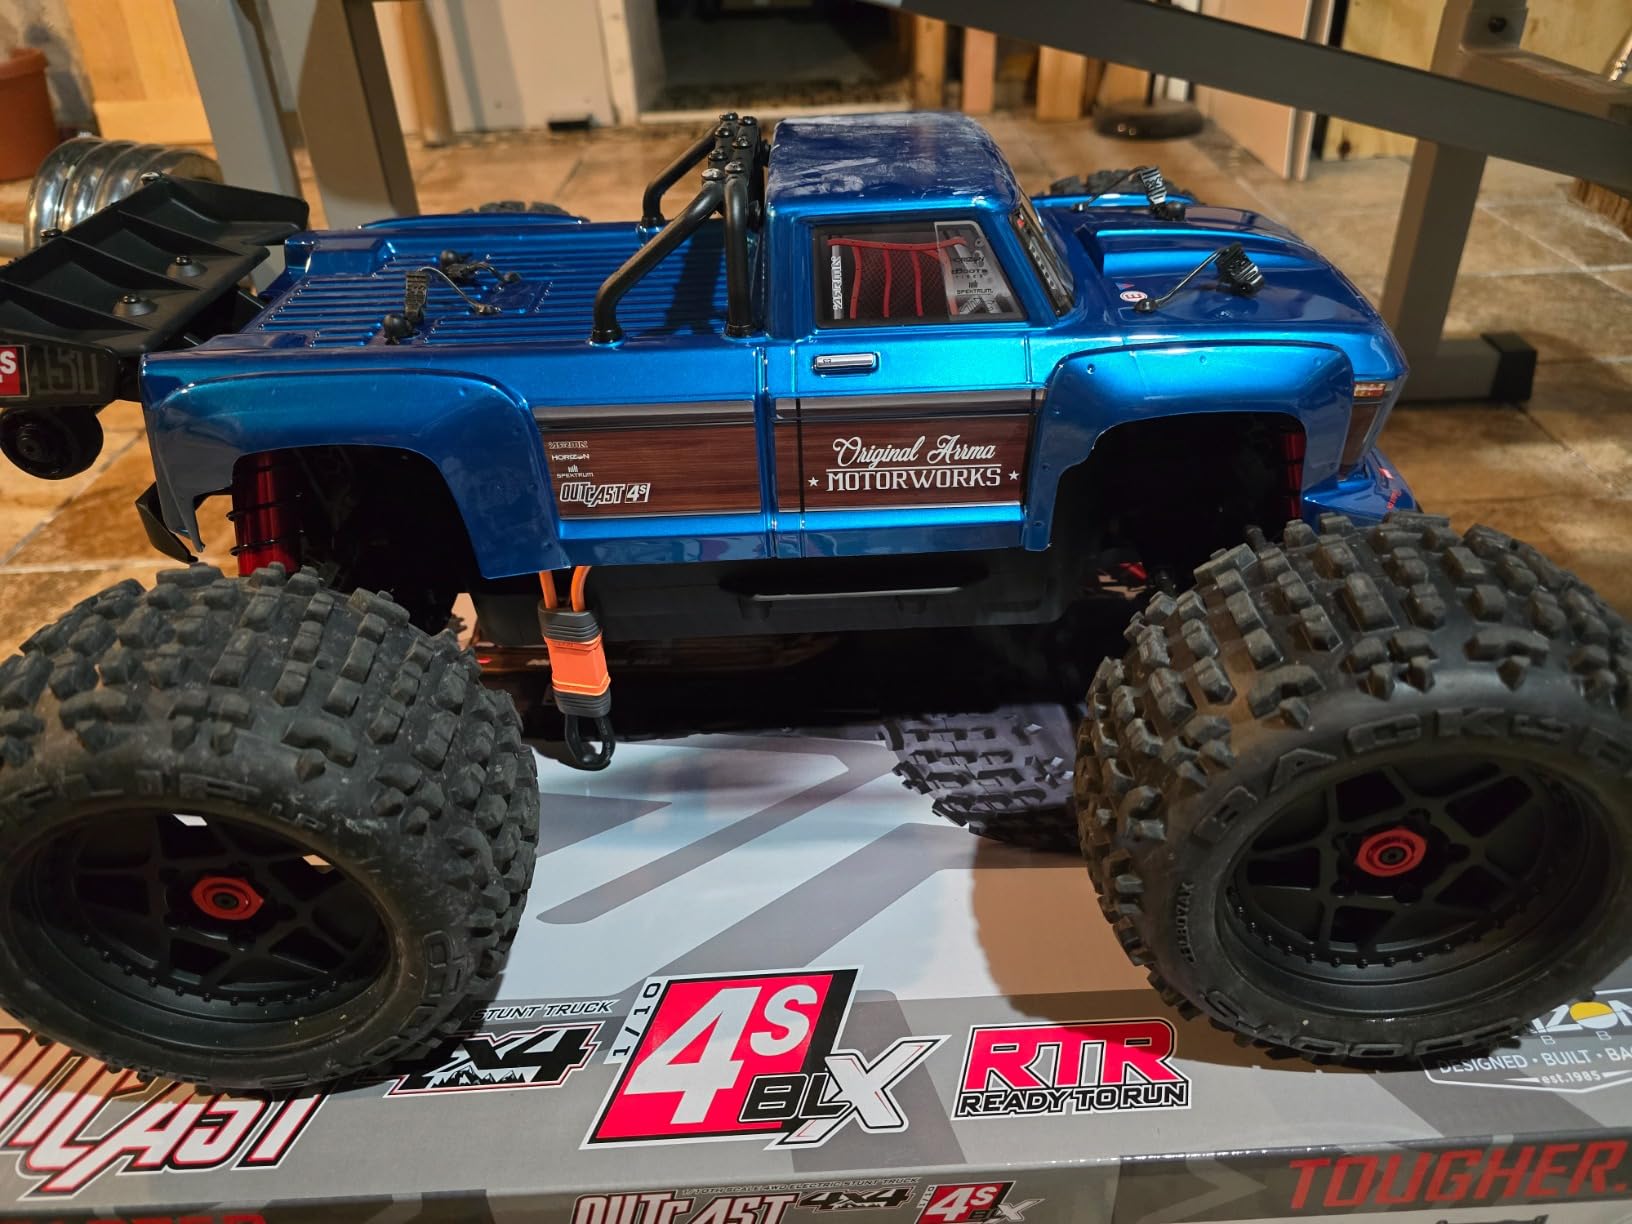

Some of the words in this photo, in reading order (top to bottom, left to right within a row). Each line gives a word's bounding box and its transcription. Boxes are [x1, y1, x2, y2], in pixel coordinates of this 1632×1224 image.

[832, 436, 926, 470] Original
[927, 434, 997, 464] Arrma
[826, 467, 1001, 492] MOTORWORKS
[559, 482, 626, 508] OUTCAST
[471, 1003, 543, 1022] STUNT
[543, 1000, 615, 1017] TRUCK
[612, 982, 661, 1057] 1/10
[964, 1019, 1184, 1092] RTR
[1540, 1049, 1592, 1067] BUILT
[1604, 1046, 1632, 1061] BA
[1541, 1070, 1602, 1084] est.1985
[737, 1034, 952, 1150] BLX
[957, 1088, 1071, 1117] READY
[1073, 1086, 1120, 1112] TO
[1120, 1082, 1187, 1108] RUN
[762, 1183, 788, 1192] 4WD
[789, 1181, 841, 1190] ELECTRIC
[843, 1179, 879, 1187] STUNT
[881, 1177, 920, 1185] TRUCK
